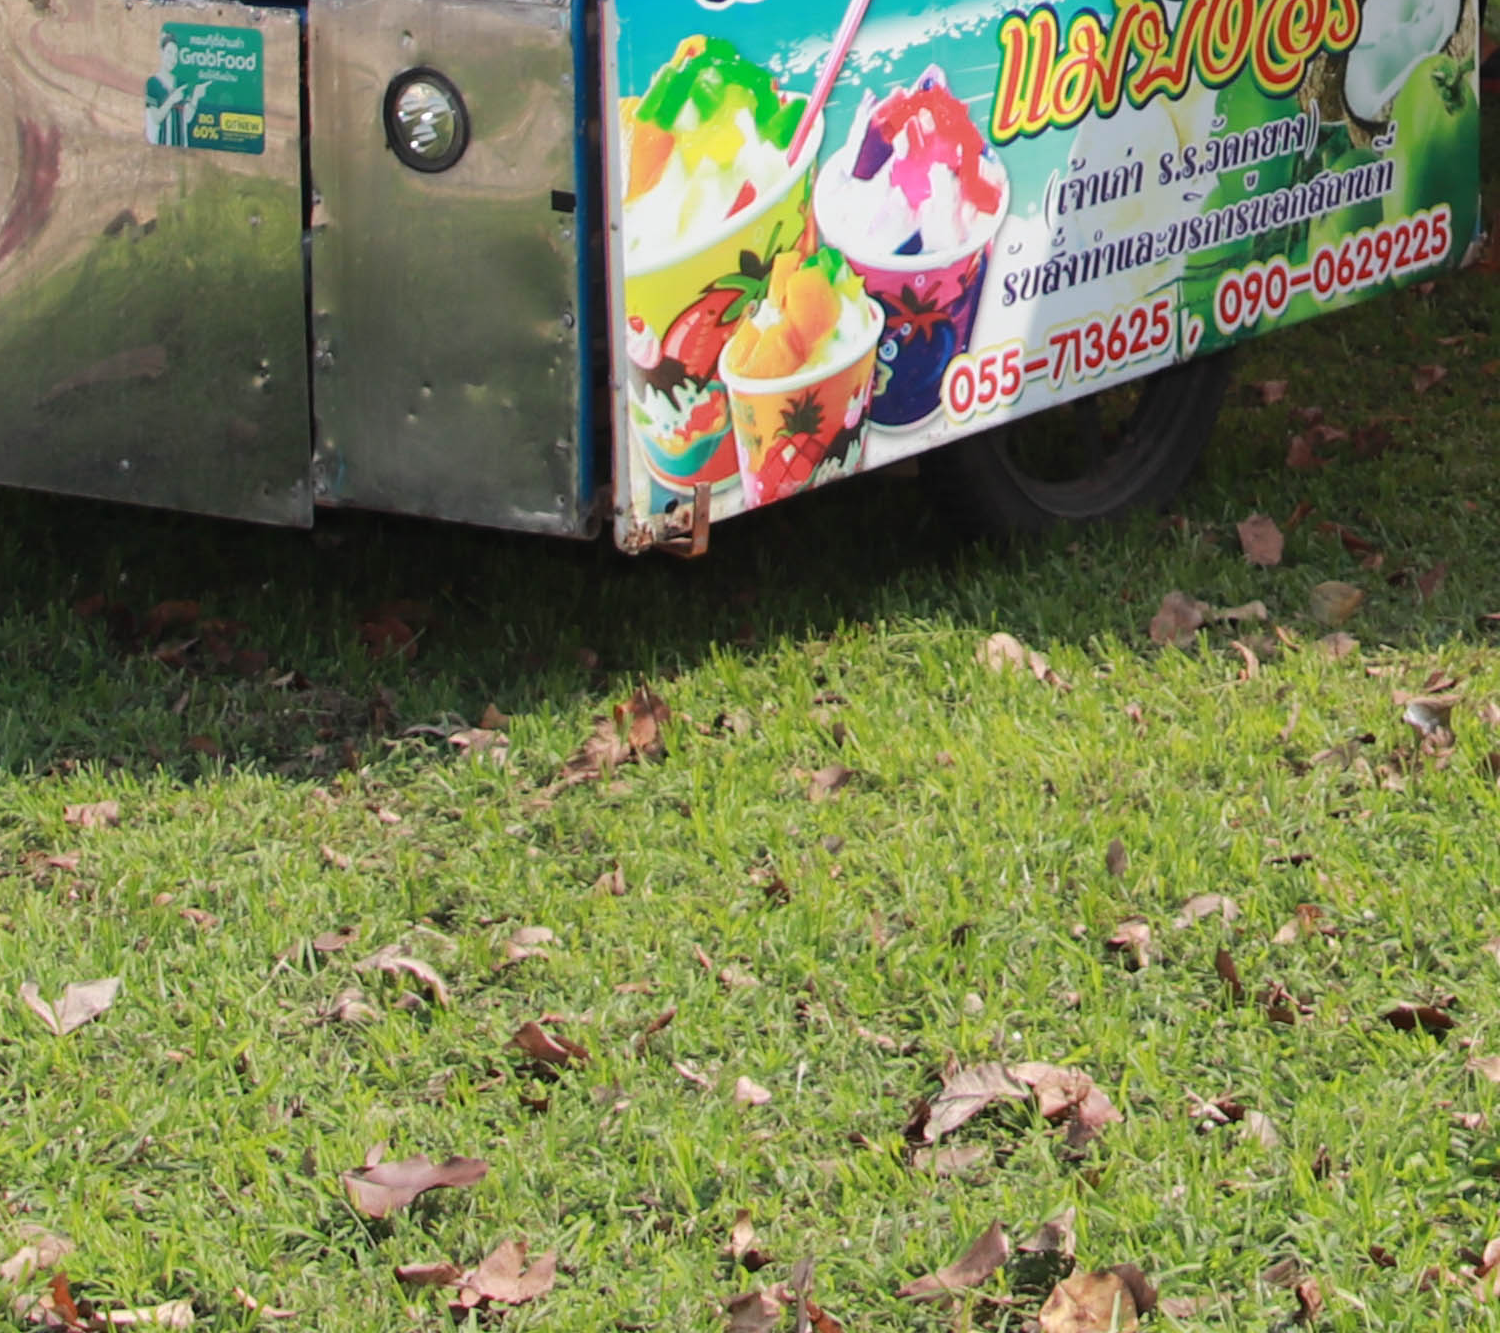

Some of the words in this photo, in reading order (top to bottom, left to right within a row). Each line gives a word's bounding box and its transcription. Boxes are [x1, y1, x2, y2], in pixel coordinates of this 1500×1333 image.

[179, 47, 258, 71] GrabFood
[1001, 121, 1397, 307] รับสั่งทำและบริการนอกสถานที่
[948, 298, 1171, 416] 055-713625
[1216, 211, 1451, 326] 090-0629225
